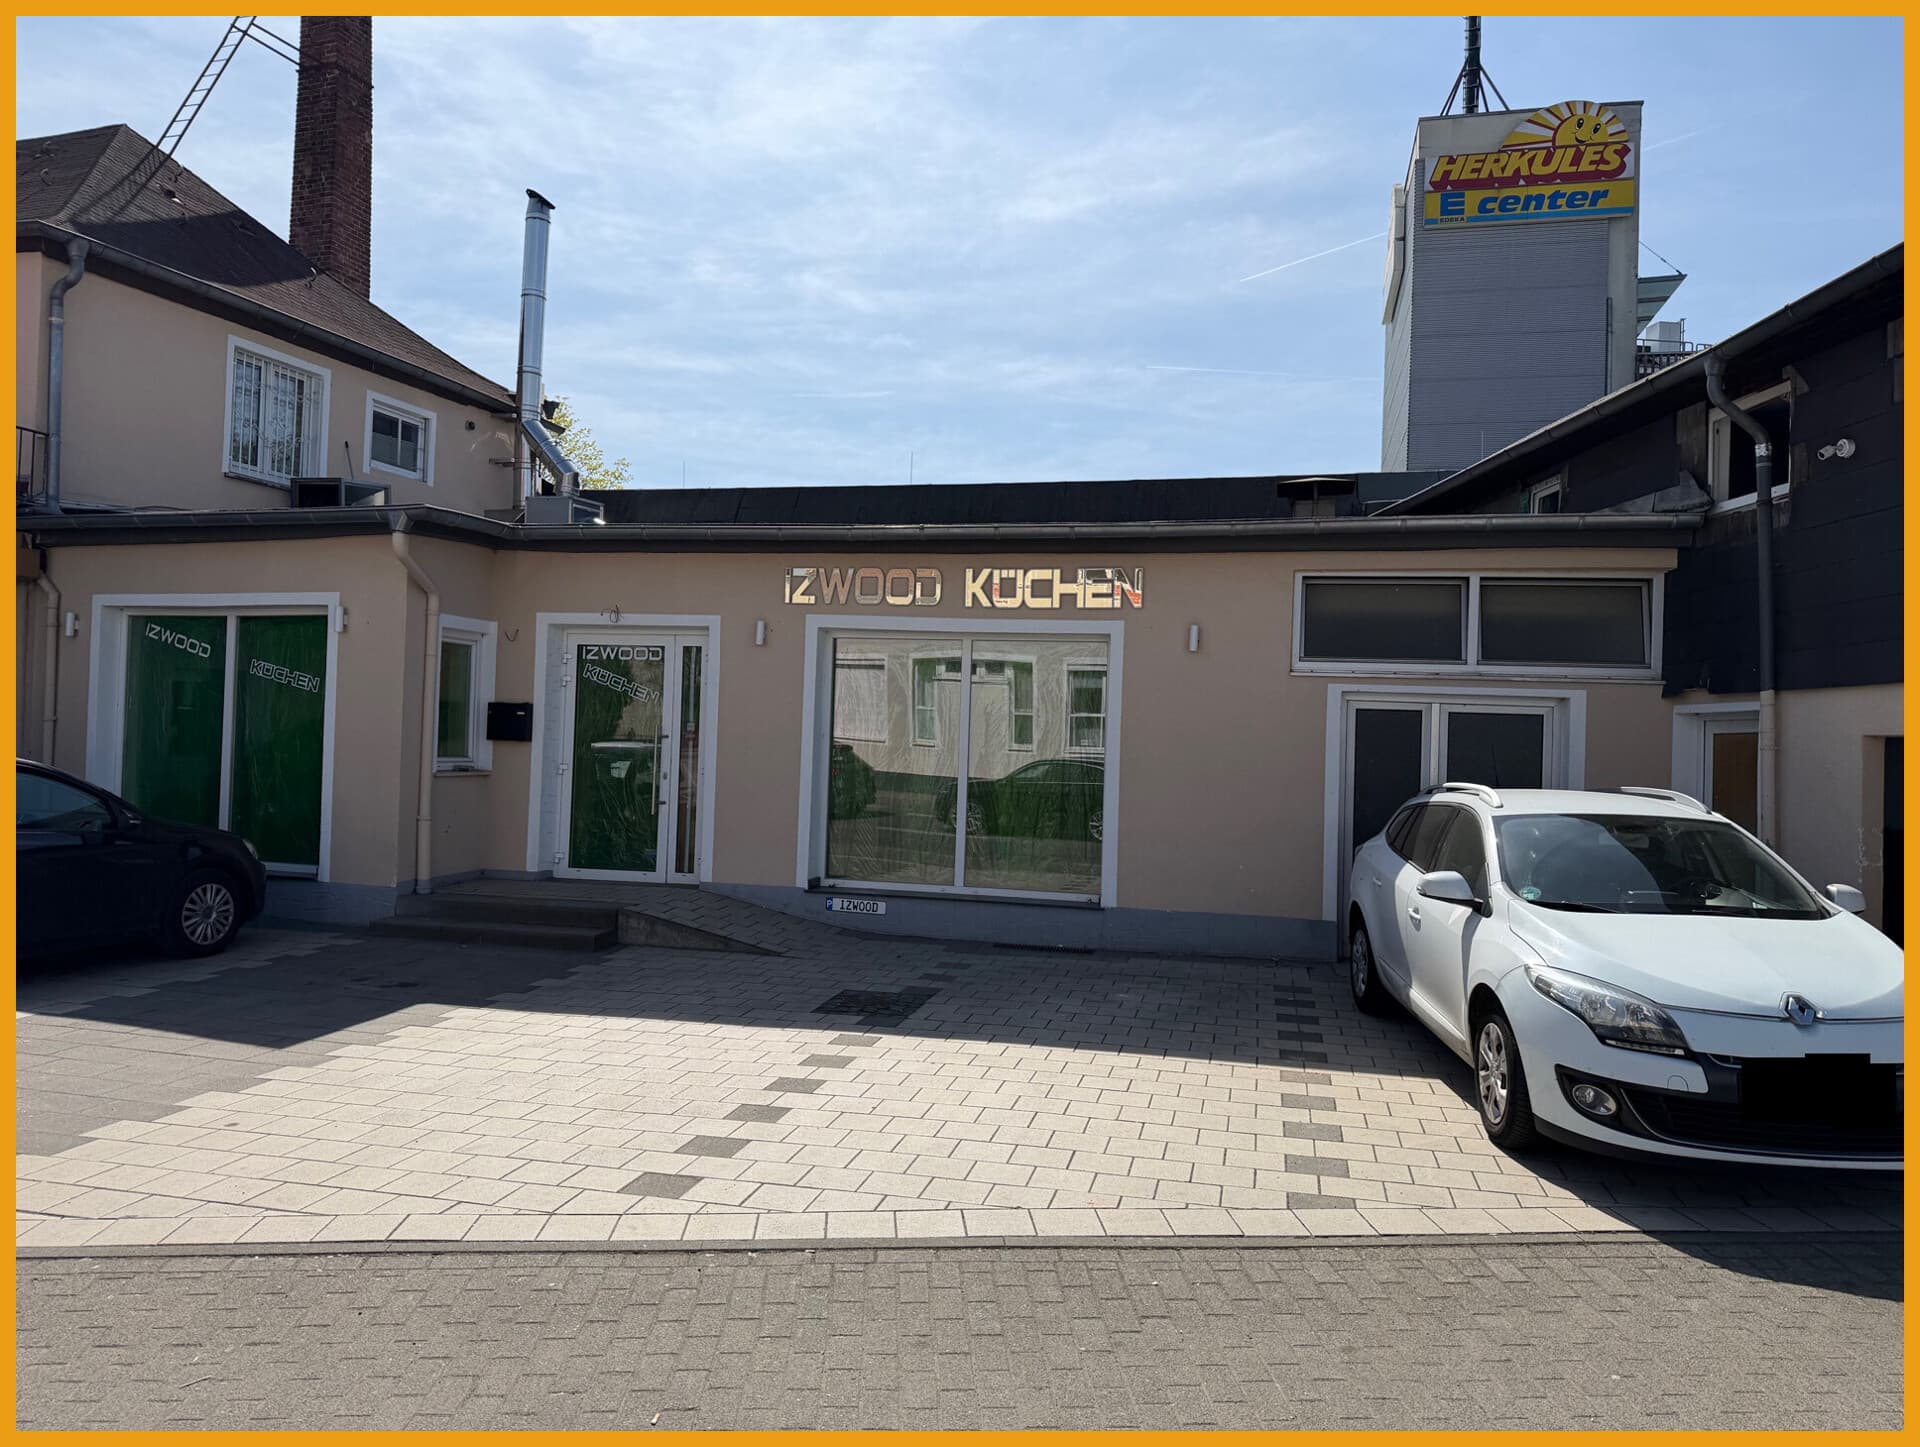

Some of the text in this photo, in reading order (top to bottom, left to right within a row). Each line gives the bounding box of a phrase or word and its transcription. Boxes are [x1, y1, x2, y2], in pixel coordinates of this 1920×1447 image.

[1430, 143, 1629, 188] HERKULES
[1440, 189, 1609, 216] E center
[784, 567, 1144, 609] IZWOOD KÜCHEN
[145, 623, 320, 693] IZWOOD KÜCHEN
[582, 646, 662, 660] IZWOOD
[583, 663, 659, 704] KÜCHEN
[839, 899, 879, 913] IZWOOD
